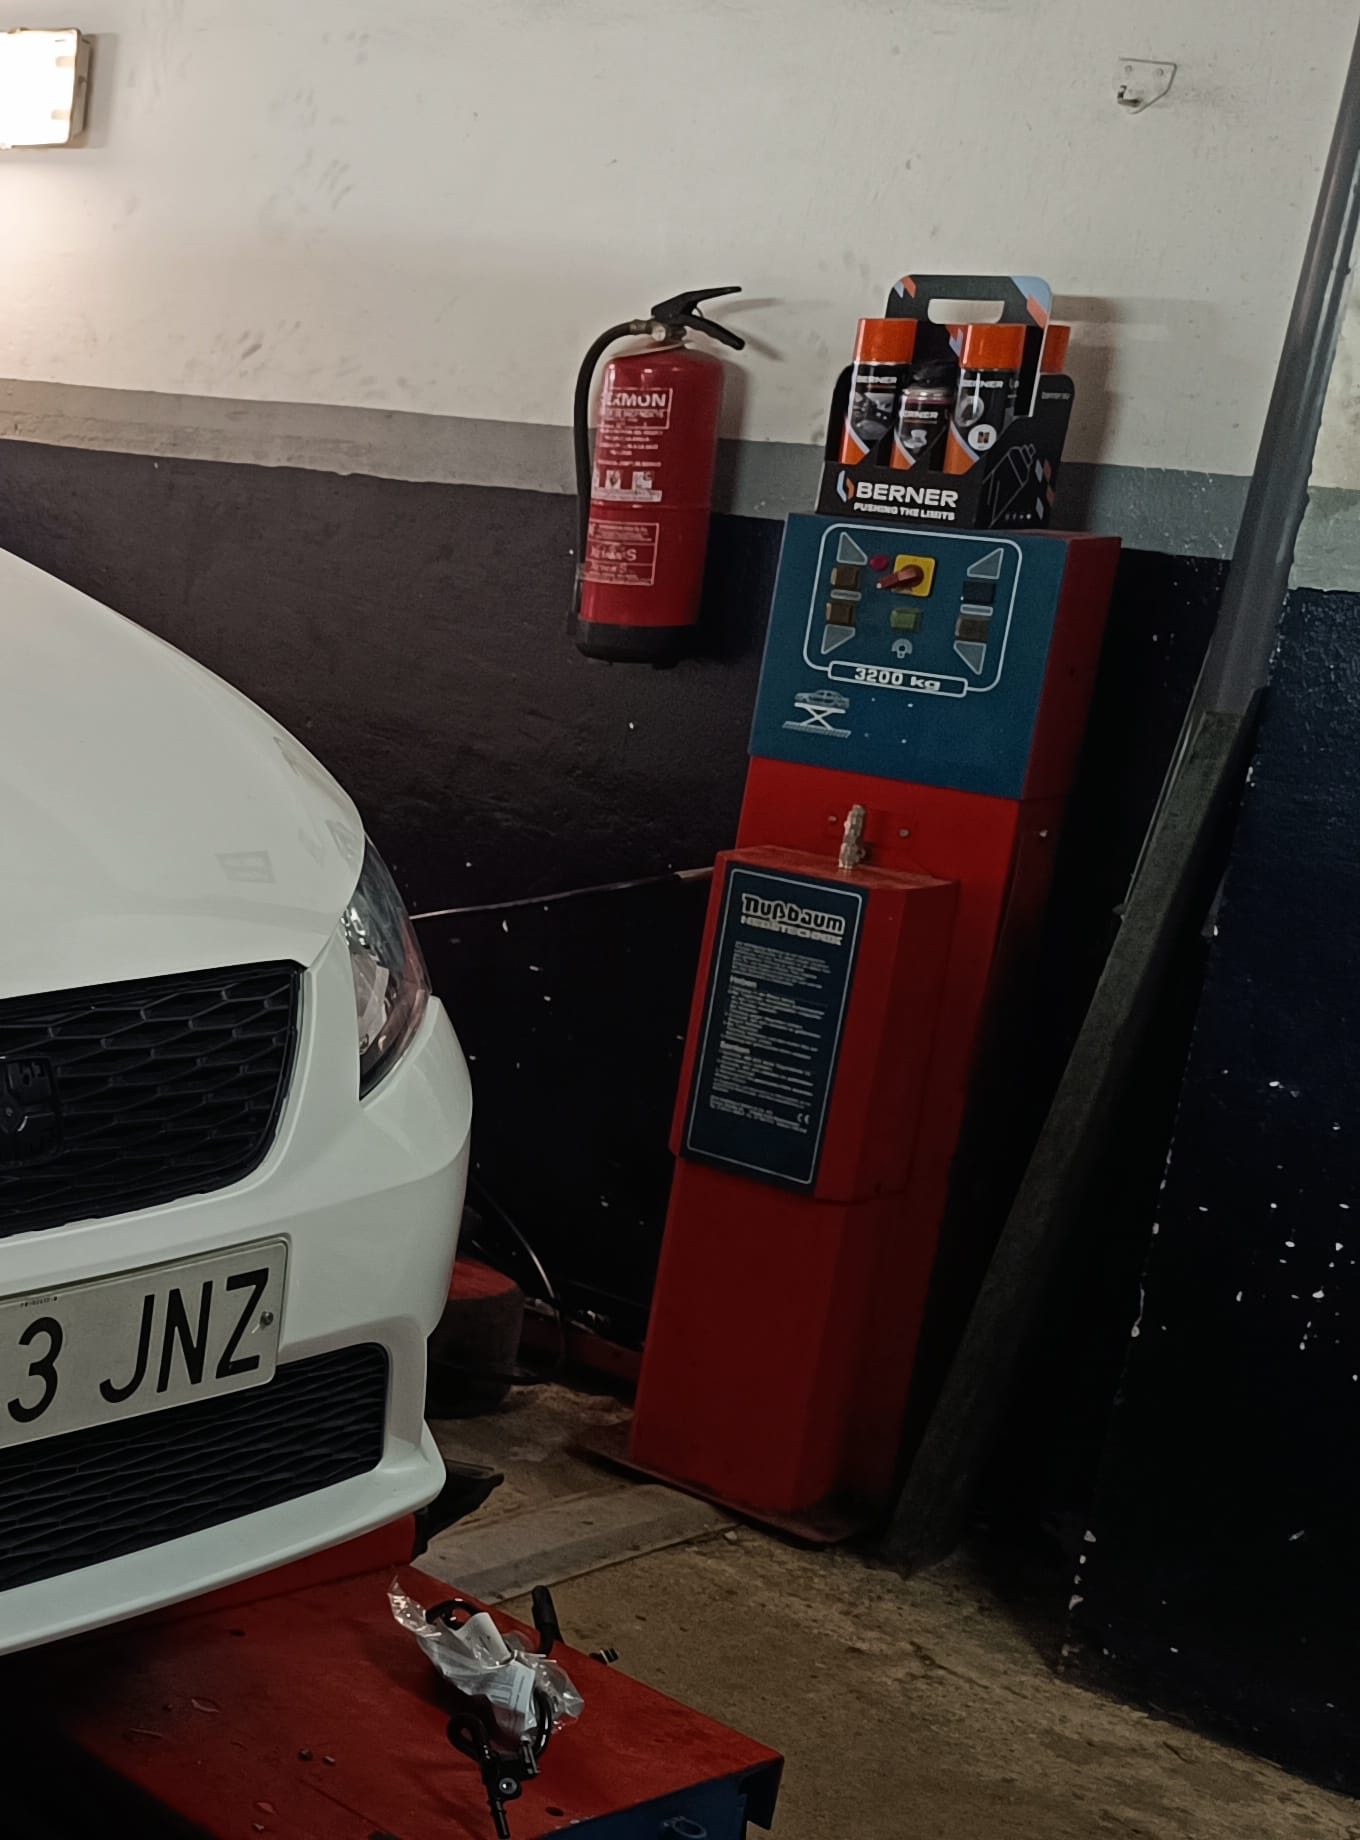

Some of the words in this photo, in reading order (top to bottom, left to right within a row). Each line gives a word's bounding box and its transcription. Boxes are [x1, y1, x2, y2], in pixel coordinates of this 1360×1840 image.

[855, 481, 959, 508] BERNER
[853, 502, 899, 515] PUSHING
[899, 507, 920, 517] THE
[920, 509, 955, 521] LIMITS
[854, 667, 904, 686] 3200
[910, 675, 941, 691] kg
[99, 1267, 270, 1404] JNZ
